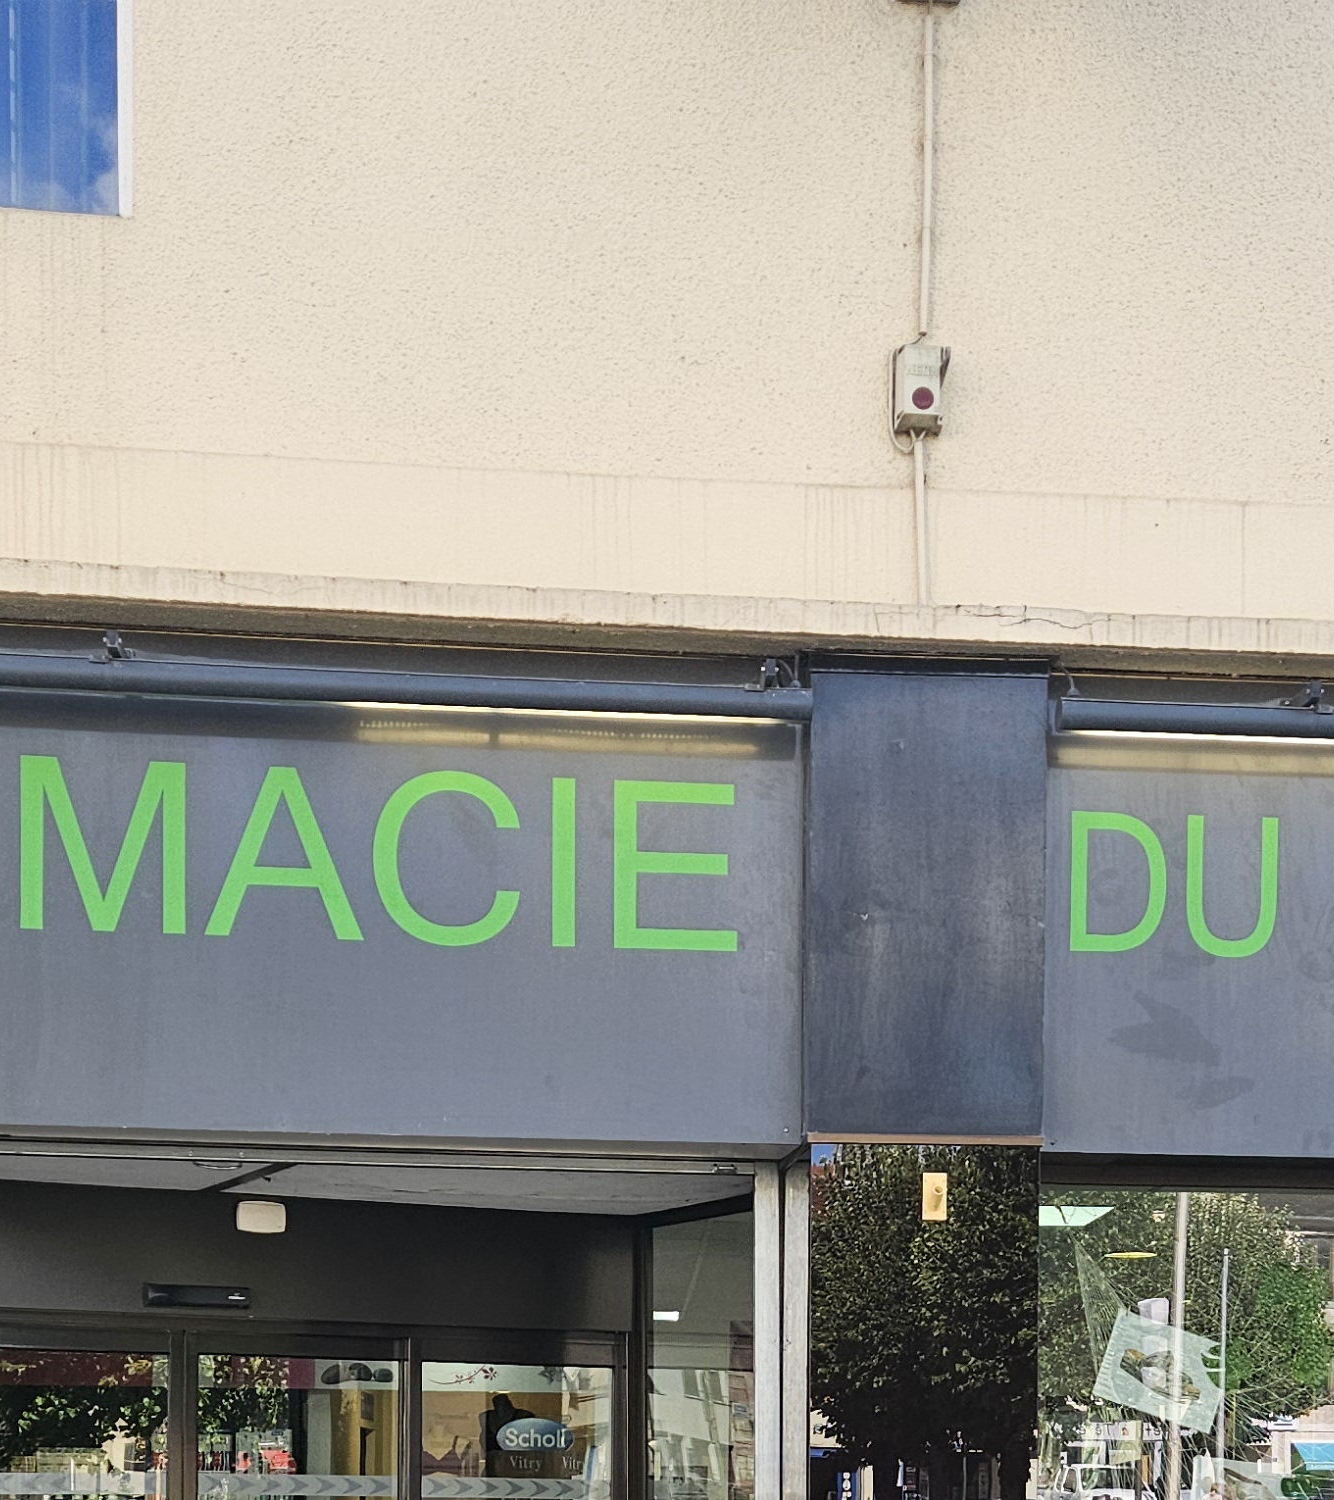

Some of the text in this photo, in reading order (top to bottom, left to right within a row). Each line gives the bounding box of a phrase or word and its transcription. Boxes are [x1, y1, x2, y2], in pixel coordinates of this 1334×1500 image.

[1069, 811, 1279, 958] DU
[505, 1427, 566, 1448] Scholl
[510, 1456, 543, 1471] Vitry
